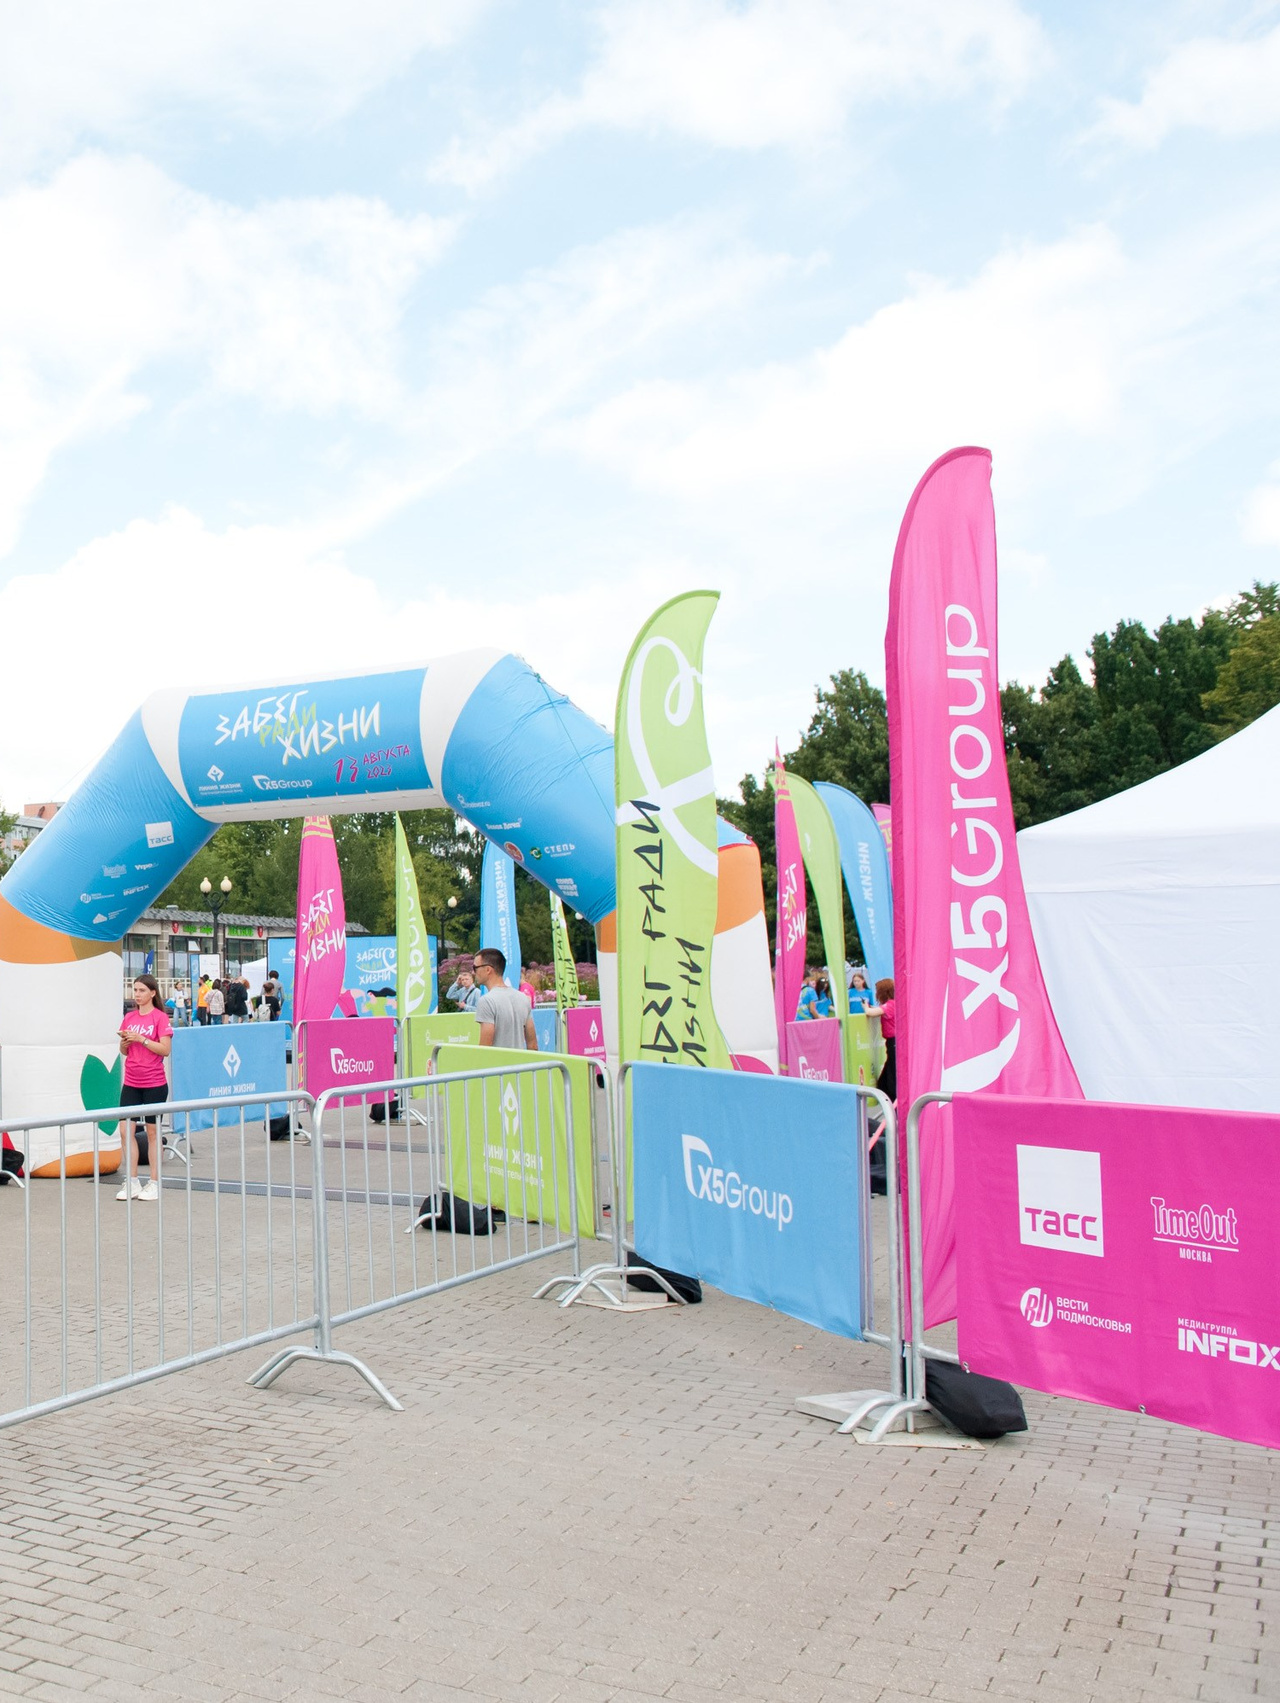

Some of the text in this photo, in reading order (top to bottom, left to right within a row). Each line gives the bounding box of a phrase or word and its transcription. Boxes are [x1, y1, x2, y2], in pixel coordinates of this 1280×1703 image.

[214, 690, 309, 746] ЗАБЕГ
[276, 701, 381, 766] ЖИЗНИ
[332, 744, 411, 784] 13 АВГУСТА
[544, 843, 576, 854] СТЕПЬ
[1179, 1247, 1213, 1263] МОСКВА
[1056, 1309, 1132, 1334] ПОДМОСКОВЬЯ
[1177, 1317, 1238, 1336] МЕДИАГРУППА
